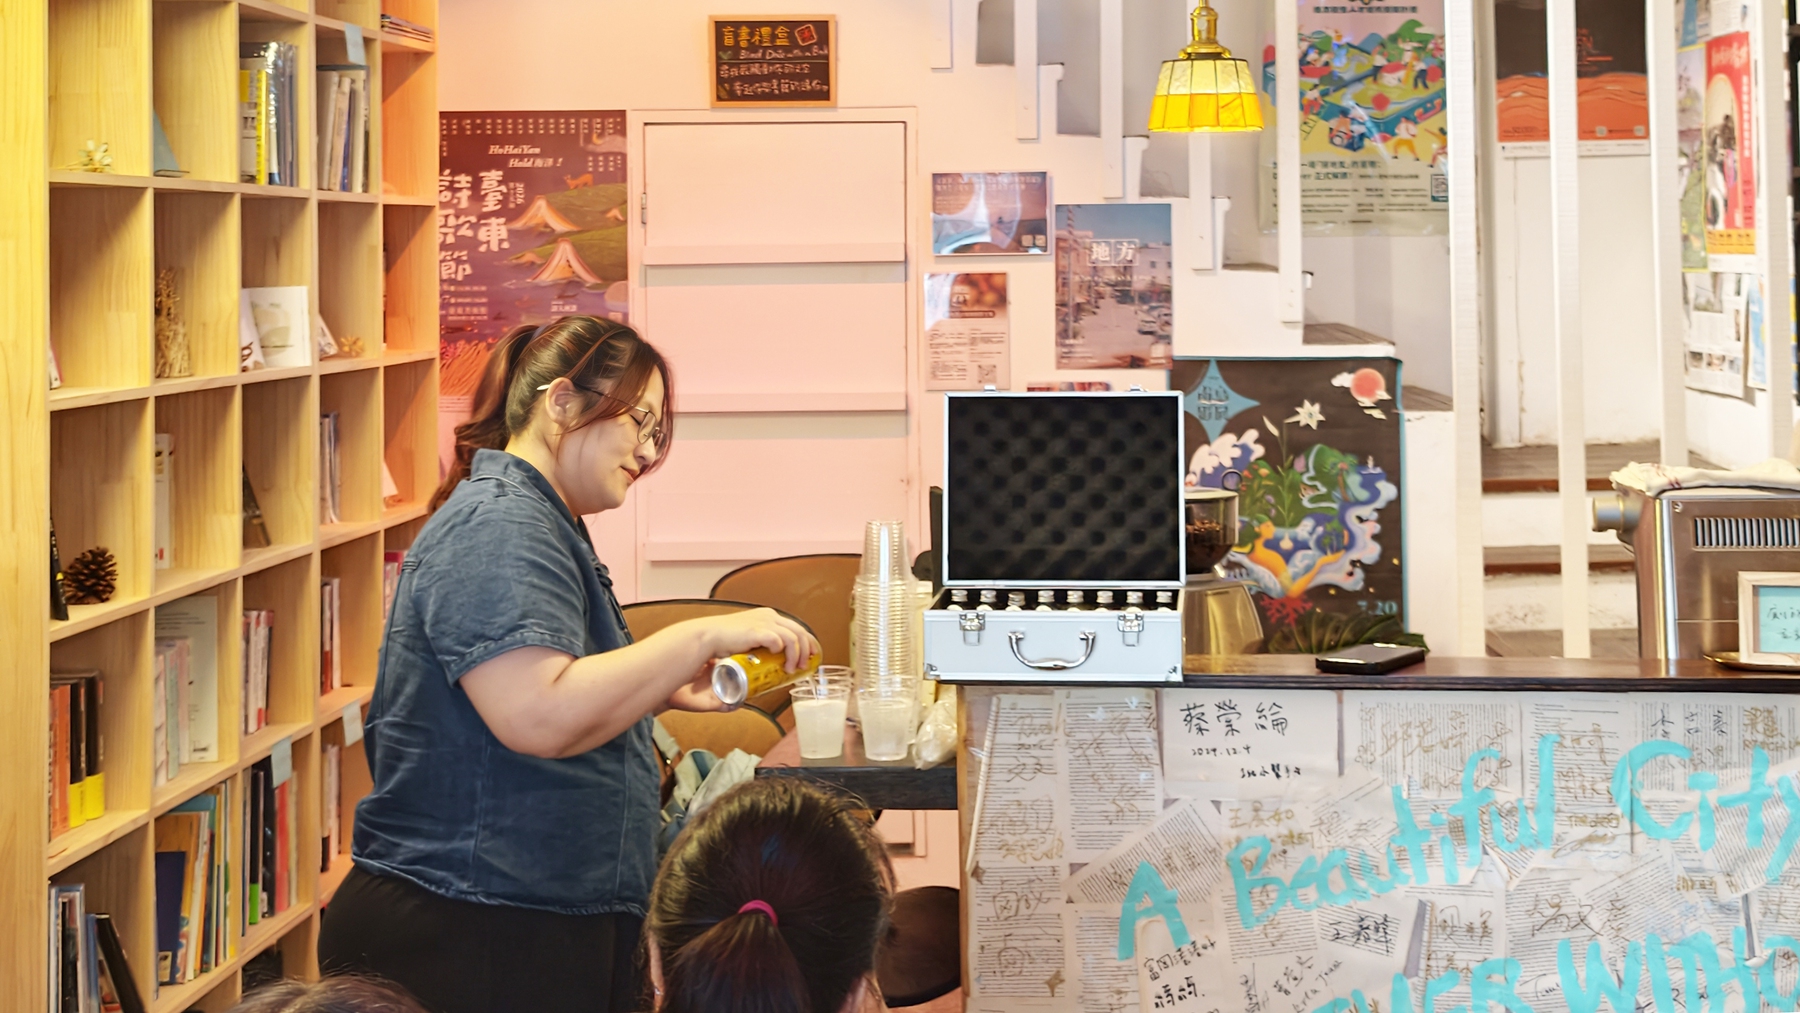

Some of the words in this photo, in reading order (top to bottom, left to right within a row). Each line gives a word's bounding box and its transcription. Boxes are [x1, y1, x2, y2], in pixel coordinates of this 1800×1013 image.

[722, 26, 790, 47] 盲書禮盒
[1090, 242, 1136, 261] 地方
[1111, 861, 1192, 961] A
[1226, 734, 1560, 930] Beautiful
